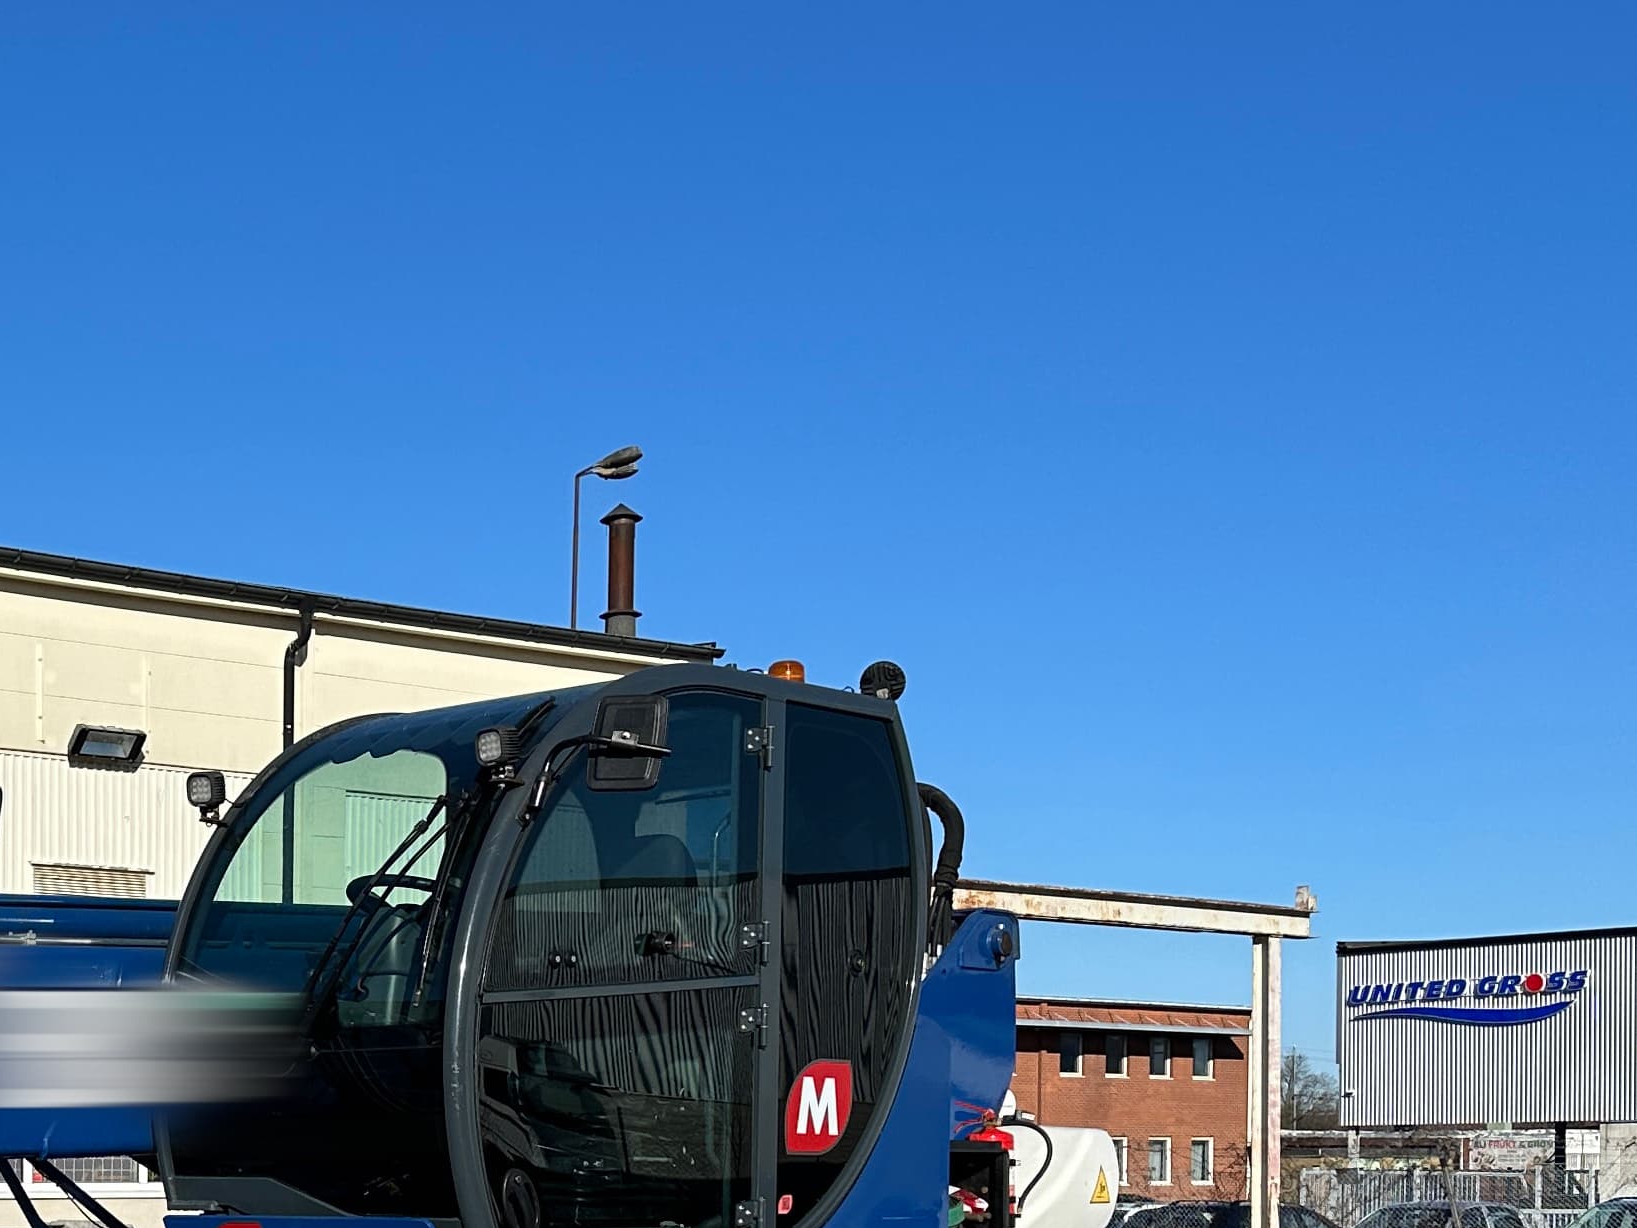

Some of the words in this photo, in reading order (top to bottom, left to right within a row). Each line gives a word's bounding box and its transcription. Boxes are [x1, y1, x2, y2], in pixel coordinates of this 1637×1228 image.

[1347, 978, 1464, 1005] UNITED
[1476, 969, 1590, 997] GROSS
[796, 1076, 839, 1136] M
